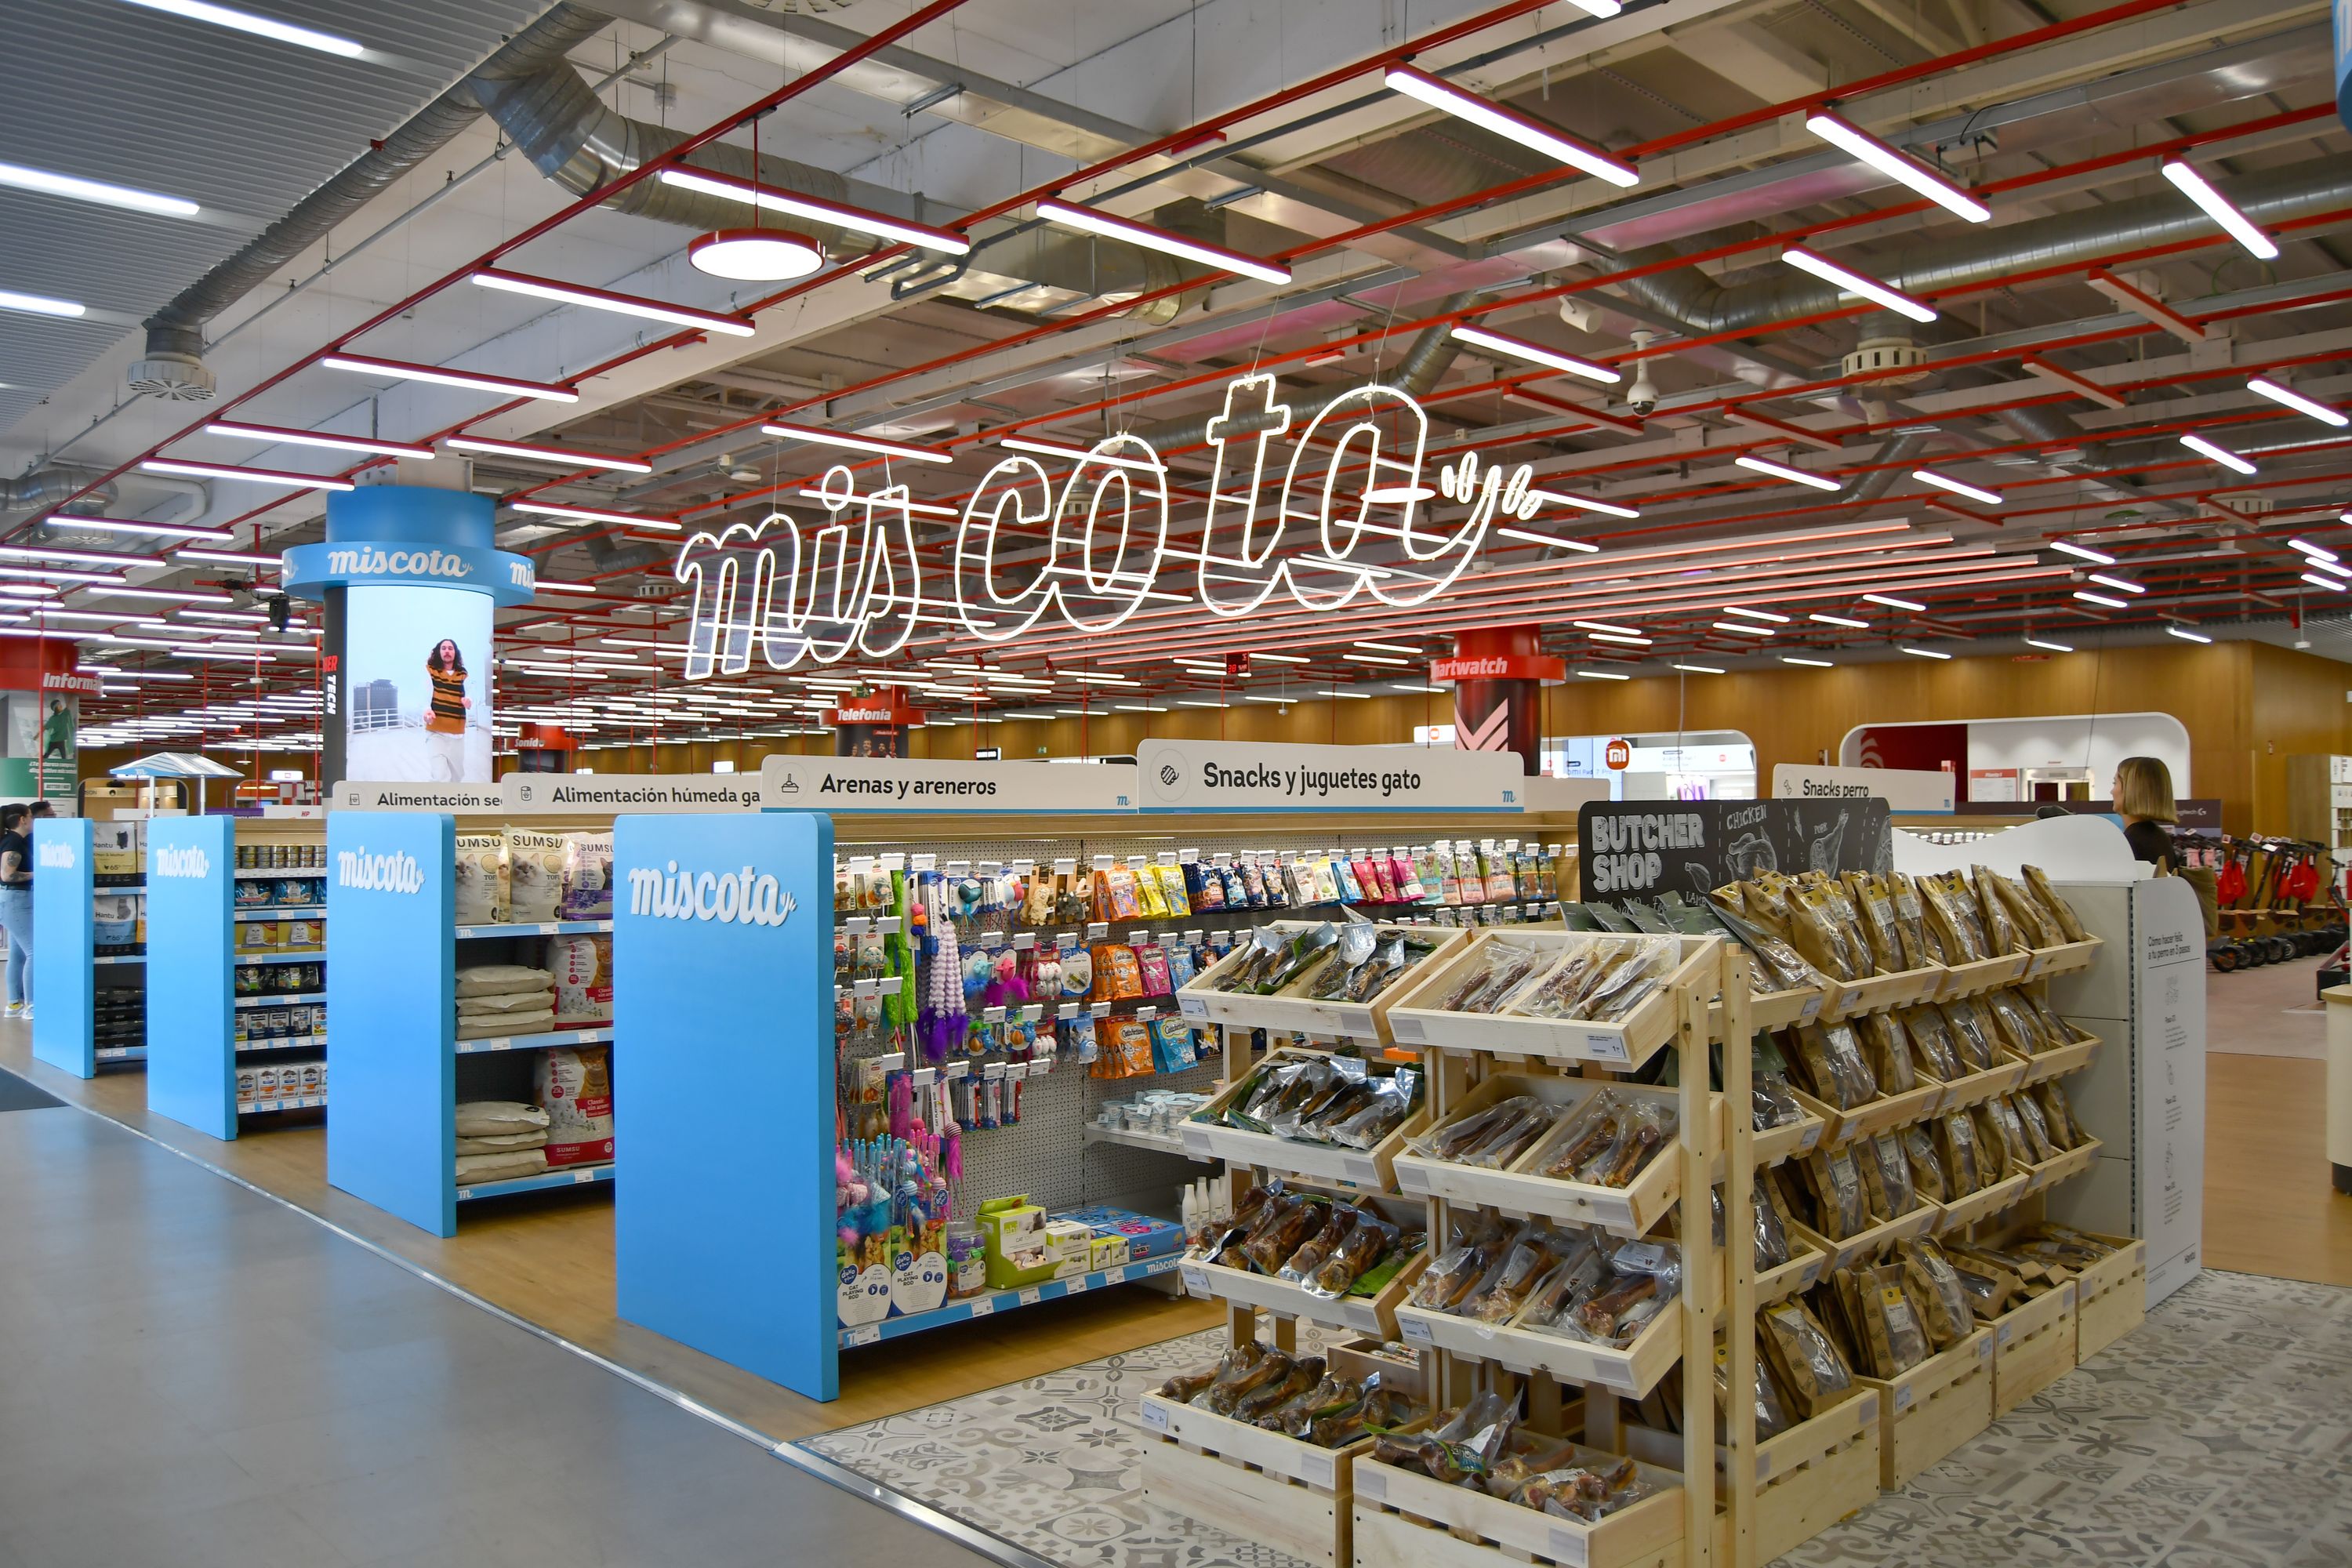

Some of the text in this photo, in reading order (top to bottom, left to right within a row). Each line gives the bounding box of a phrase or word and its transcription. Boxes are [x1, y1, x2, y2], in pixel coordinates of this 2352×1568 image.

[674, 371, 1544, 682] miscota
[327, 546, 474, 578] miscota
[327, 675, 337, 715] TECH
[837, 708, 891, 721] Telefonía
[514, 738, 545, 747] Sonido
[820, 773, 996, 800] Arenas y areneros
[1203, 762, 1421, 797] Snacks y juguetes gato
[1803, 779, 1869, 797] Snacks perro
[377, 793, 480, 807] Alimentación
[552, 786, 667, 803] Alimentación
[672, 787, 738, 803] húmeda
[1726, 804, 1767, 829] CHICKEN
[1814, 822, 1828, 834] PORK
[513, 835, 563, 848] SUMSU
[1592, 814, 1705, 853] BUTCHER
[40, 840, 74, 869] miscota
[156, 844, 210, 879] miscota
[338, 845, 425, 894] miscota
[1592, 852, 1662, 893] SHOP
[628, 860, 797, 927] miscota
[896, 1256, 910, 1265] duvo
[842, 1288, 864, 1297] PLAYING
